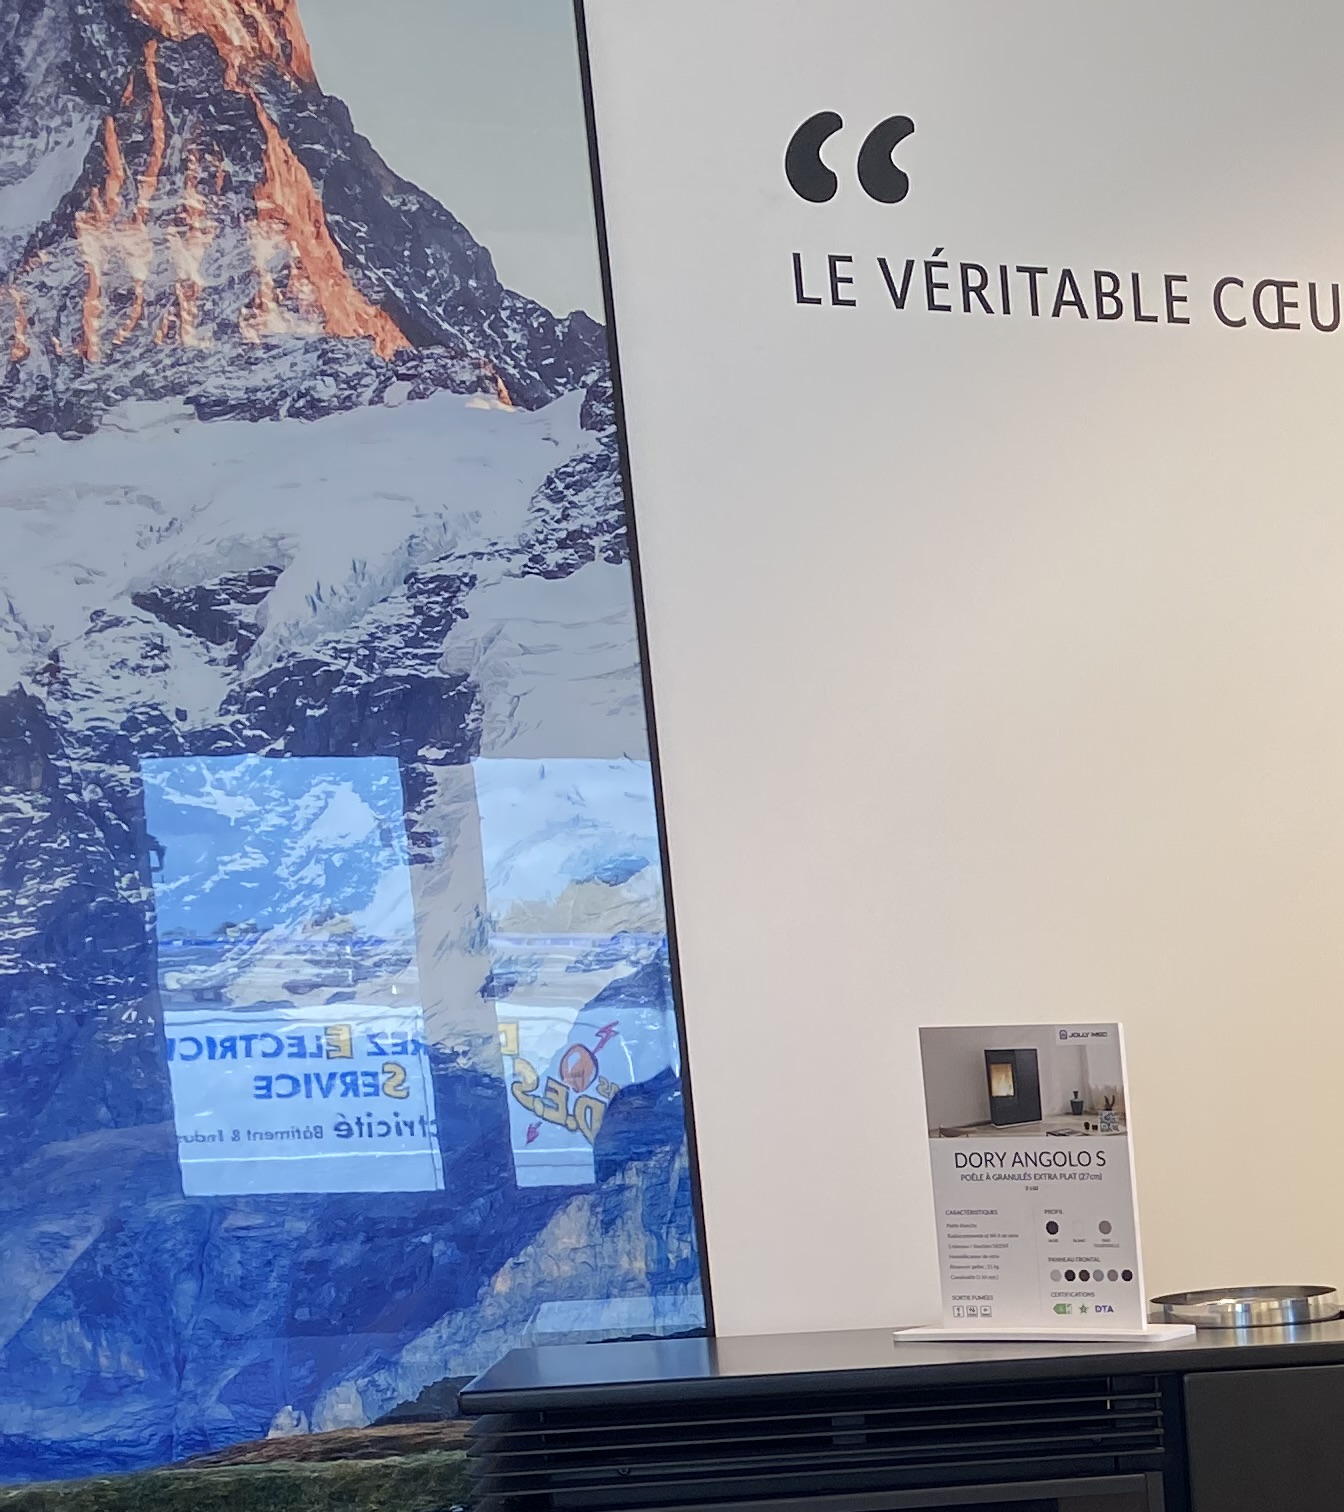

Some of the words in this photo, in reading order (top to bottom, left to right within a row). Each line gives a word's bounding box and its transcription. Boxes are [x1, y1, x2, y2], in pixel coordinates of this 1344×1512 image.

[791, 252, 858, 309] LE
[876, 247, 1192, 326] VÉRITABLE
[954, 1152, 1007, 1168] DORY
[1011, 1150, 1092, 1168] ANGOLO
[1095, 1150, 1106, 1167] S
[992, 1171, 1032, 1181] GRANULÉS
[1033, 1172, 1058, 1181] EXTRA
[1059, 1172, 1077, 1181] PLAT
[1095, 1305, 1114, 1313] DTA
